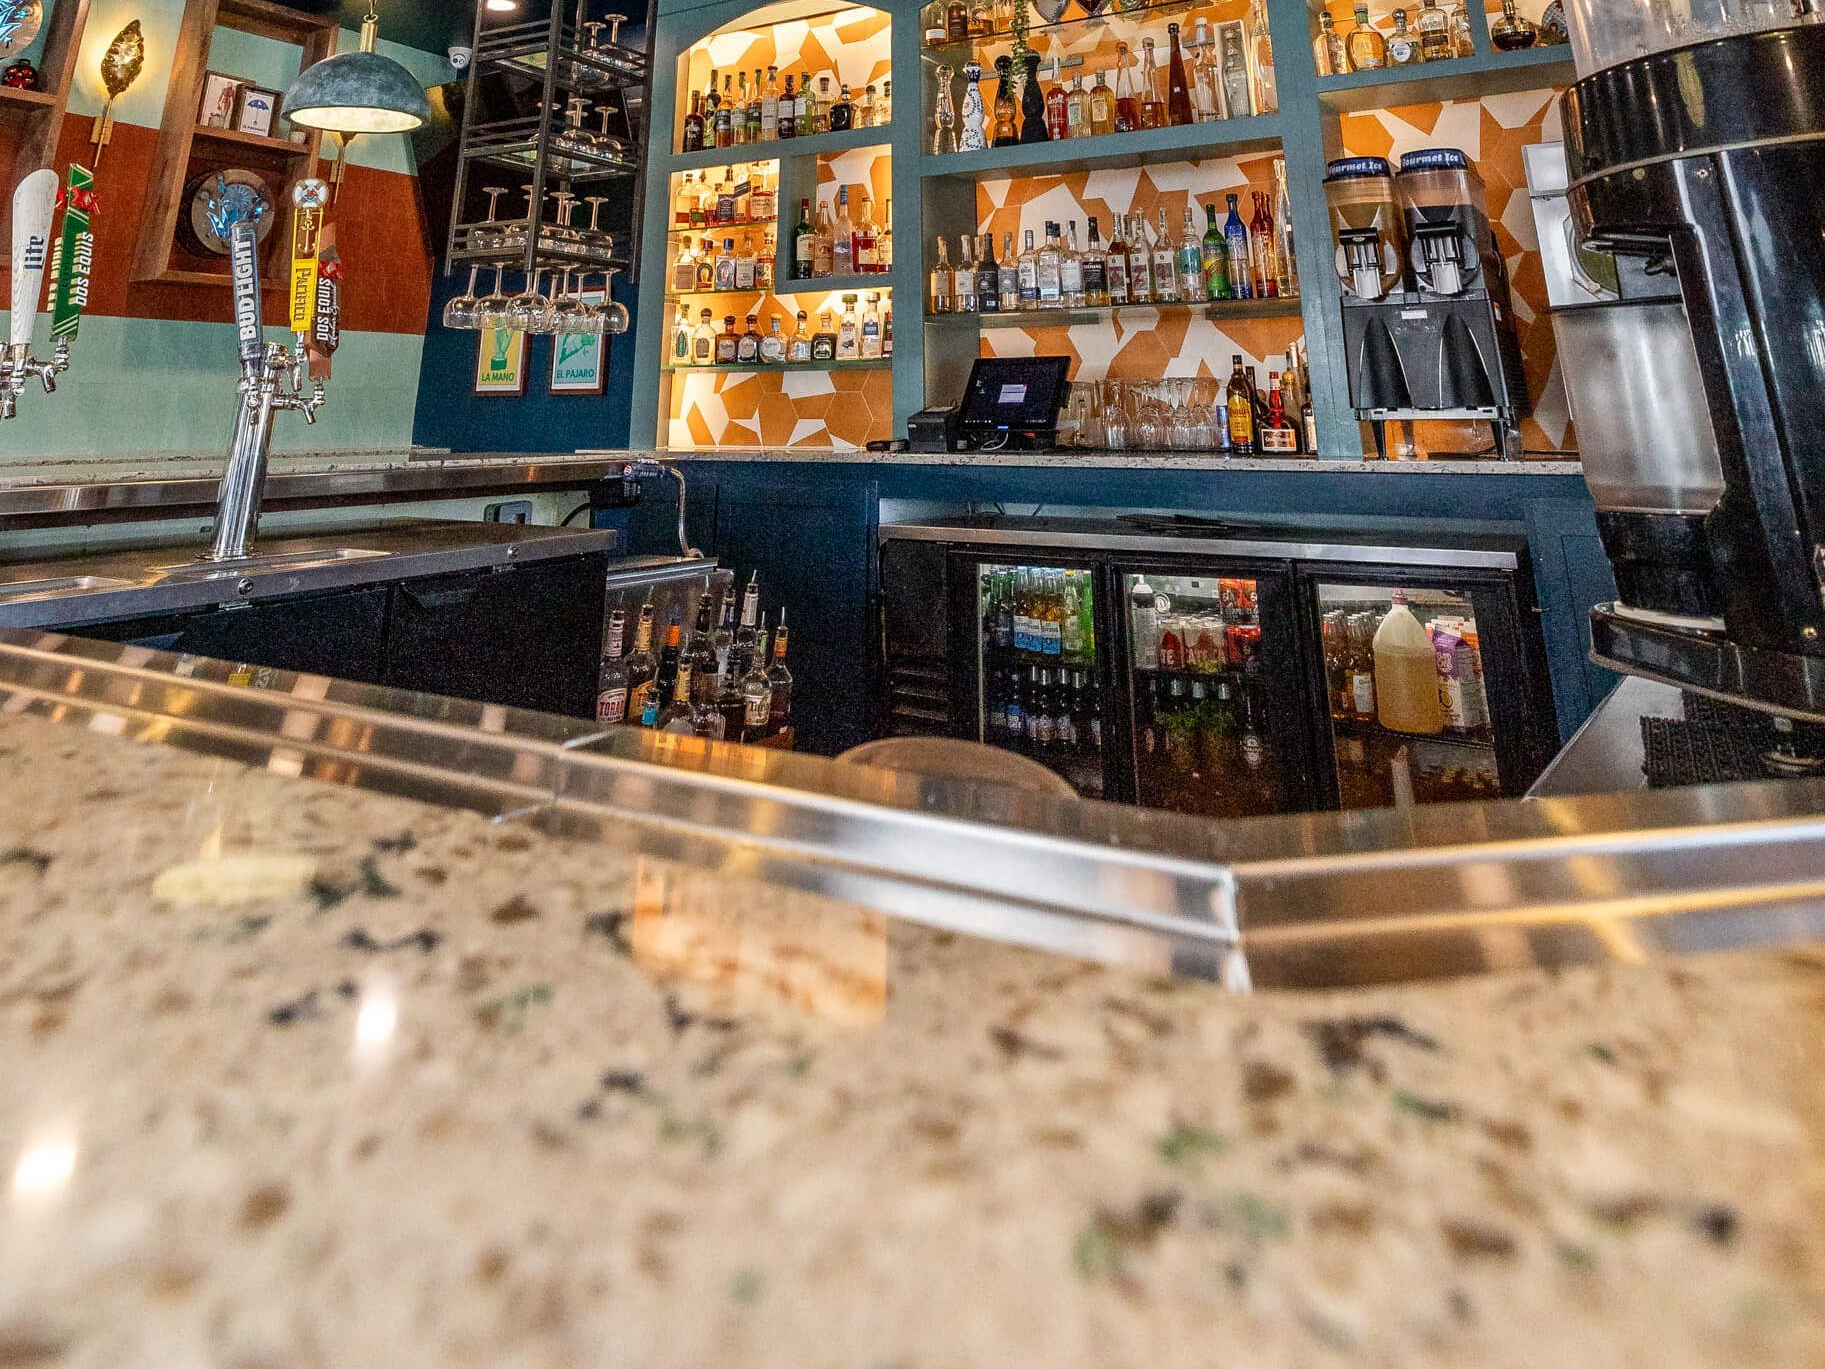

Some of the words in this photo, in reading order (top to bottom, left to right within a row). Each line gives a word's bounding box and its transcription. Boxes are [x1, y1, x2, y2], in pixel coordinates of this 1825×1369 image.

[1443, 152, 1459, 166] Ice
[79, 231, 94, 275] EQUIS
[76, 277, 89, 306] DOS
[317, 277, 331, 314] EQUIS
[239, 297, 257, 341] BUD
[316, 316, 329, 341] DOS
[481, 373, 490, 382] LA
[491, 372, 515, 382] MANO
[556, 370, 565, 379] EL
[566, 369, 595, 379] PAJARO
